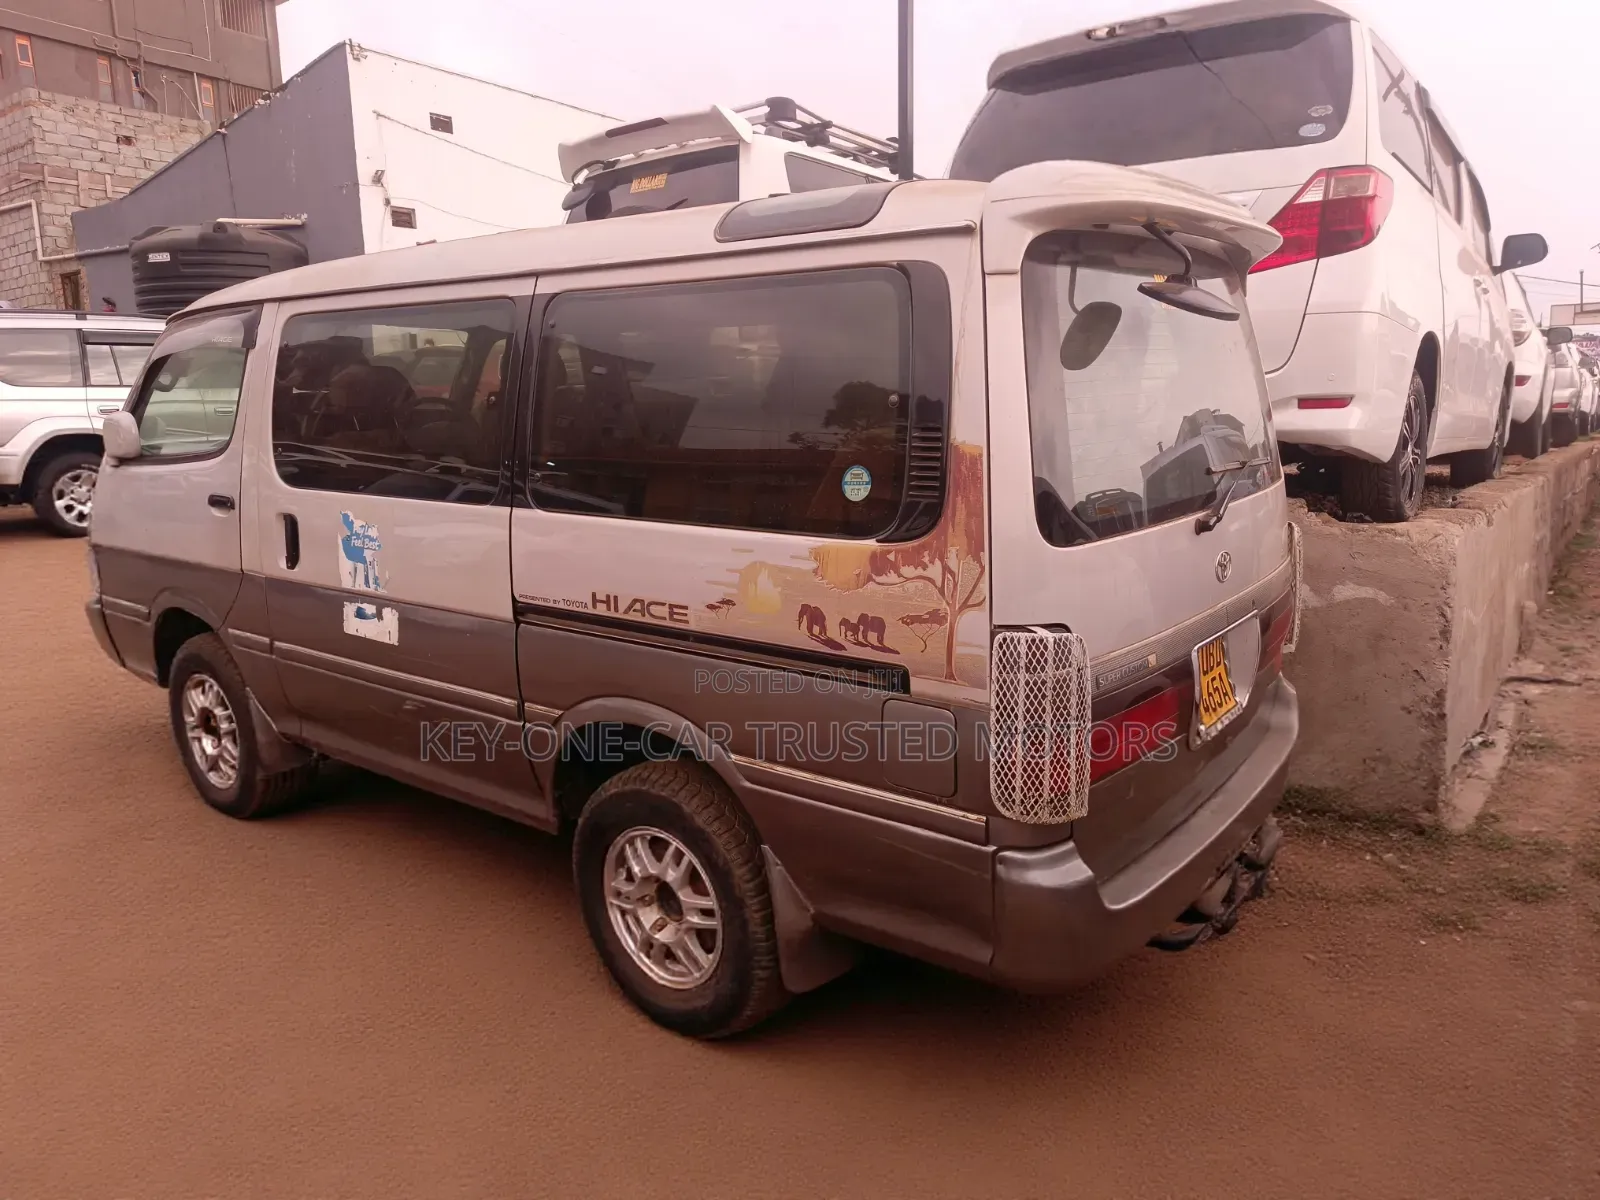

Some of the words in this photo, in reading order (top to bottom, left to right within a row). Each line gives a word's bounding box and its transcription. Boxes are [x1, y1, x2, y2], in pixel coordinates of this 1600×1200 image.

[351, 536, 364, 548] Feel
[364, 537, 380, 550] Best
[518, 594, 551, 604] PRESENTED
[561, 598, 589, 610] TOYOTA
[591, 591, 690, 625] HIACE
[1099, 672, 1121, 687] SUPER
[1121, 659, 1149, 678] CUSTOM
